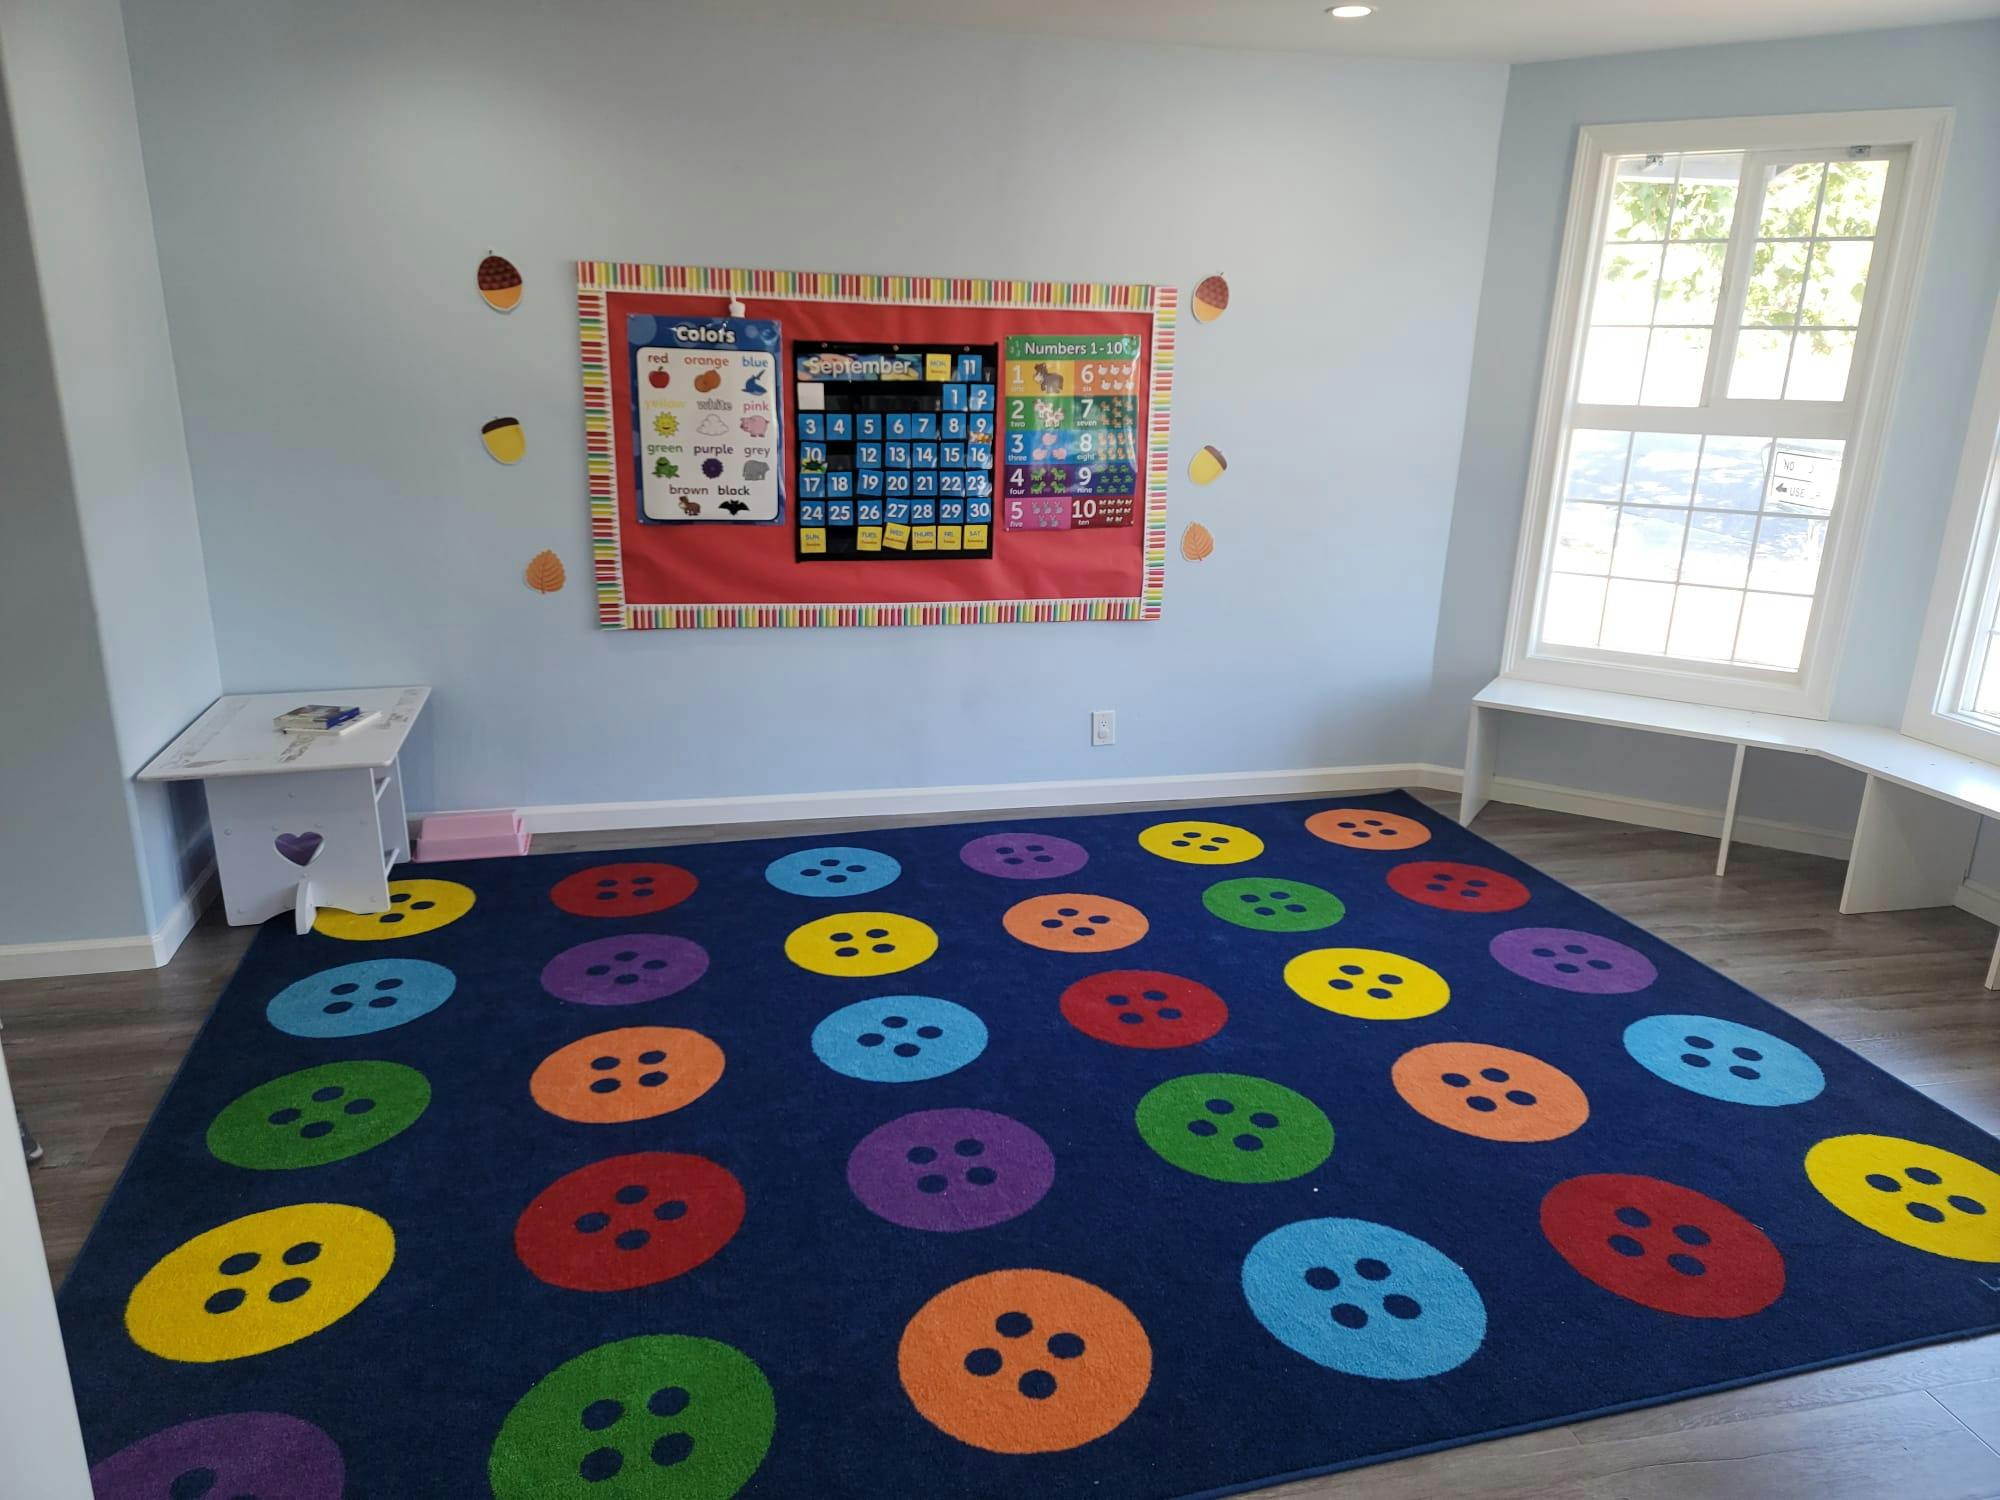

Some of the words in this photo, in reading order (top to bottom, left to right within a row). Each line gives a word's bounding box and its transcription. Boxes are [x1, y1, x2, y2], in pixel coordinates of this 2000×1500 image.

[676, 325, 736, 343] Colors
[1025, 342, 1087, 354] Numbers
[647, 353, 669, 363] red
[684, 356, 729, 369] orange
[742, 356, 768, 368] blue
[809, 356, 912, 378] September
[963, 360, 976, 375] 11
[1012, 365, 1024, 384] 1
[1081, 365, 1094, 383] 6
[952, 389, 957, 405] 1
[978, 390, 987, 406] 2
[697, 399, 733, 411] white
[743, 401, 769, 414] pink
[1012, 400, 1025, 419] 2
[1082, 399, 1094, 418] 7
[805, 419, 816, 434] 3
[834, 419, 845, 434] 4
[864, 419, 874, 434] 5
[894, 419, 904, 434] 6
[919, 418, 929, 432] 7
[949, 418, 959, 433] 8
[976, 418, 986, 433] 9
[647, 445, 683, 455] green
[694, 445, 734, 455] purple
[744, 447, 770, 457] grey
[1011, 434, 1024, 453] 3
[1080, 434, 1093, 452] 8
[860, 448, 877, 462] 12
[889, 447, 905, 461] 13
[916, 448, 933, 462] 14
[944, 447, 960, 462] 15
[971, 447, 986, 462] 16
[1008, 454, 1027, 462] three
[1077, 453, 1095, 461] eight
[1783, 458, 1795, 471] NO
[804, 477, 820, 492] 17
[831, 477, 848, 491] 18
[862, 475, 879, 489] 19
[887, 476, 908, 491] 20
[917, 476, 933, 491] 21
[942, 476, 961, 491] 22
[967, 475, 986, 490] 23
[1010, 469, 1025, 487] 4
[1078, 468, 1091, 486] 9
[669, 485, 708, 495] brown
[718, 486, 750, 496] black
[1789, 487, 1805, 498] USE
[802, 506, 823, 520] 24
[830, 506, 850, 520] 25
[860, 505, 880, 520] 26
[887, 503, 908, 518] 27
[913, 504, 933, 518] 28
[942, 503, 961, 518] 29
[970, 503, 990, 517] 30
[1011, 502, 1023, 520] 5
[1072, 500, 1097, 518] 10
